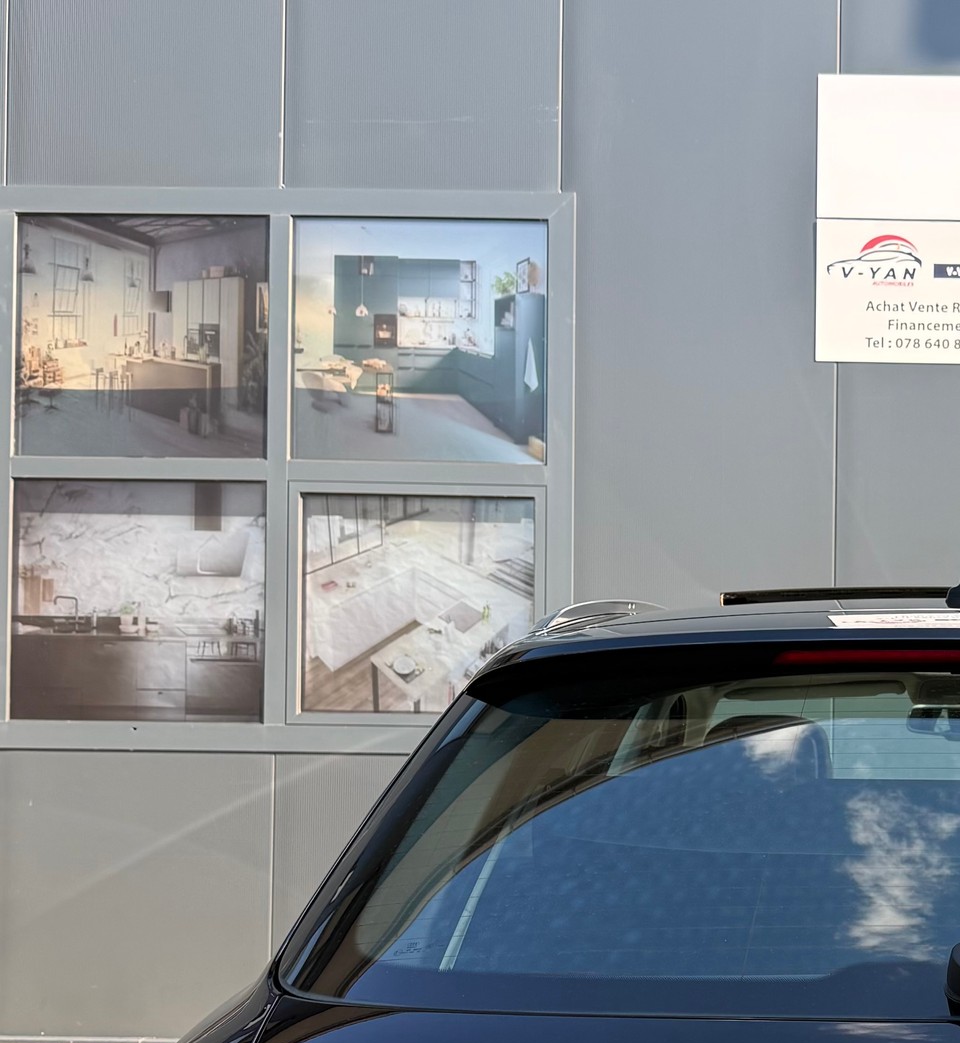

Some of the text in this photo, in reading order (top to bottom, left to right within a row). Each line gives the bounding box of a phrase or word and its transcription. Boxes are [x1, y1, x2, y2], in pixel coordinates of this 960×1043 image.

[842, 266, 916, 280] V-YAN
[866, 300, 905, 312] Achat
[908, 301, 948, 313] Vente
[895, 338, 920, 349] 078
[924, 338, 950, 349] 640
